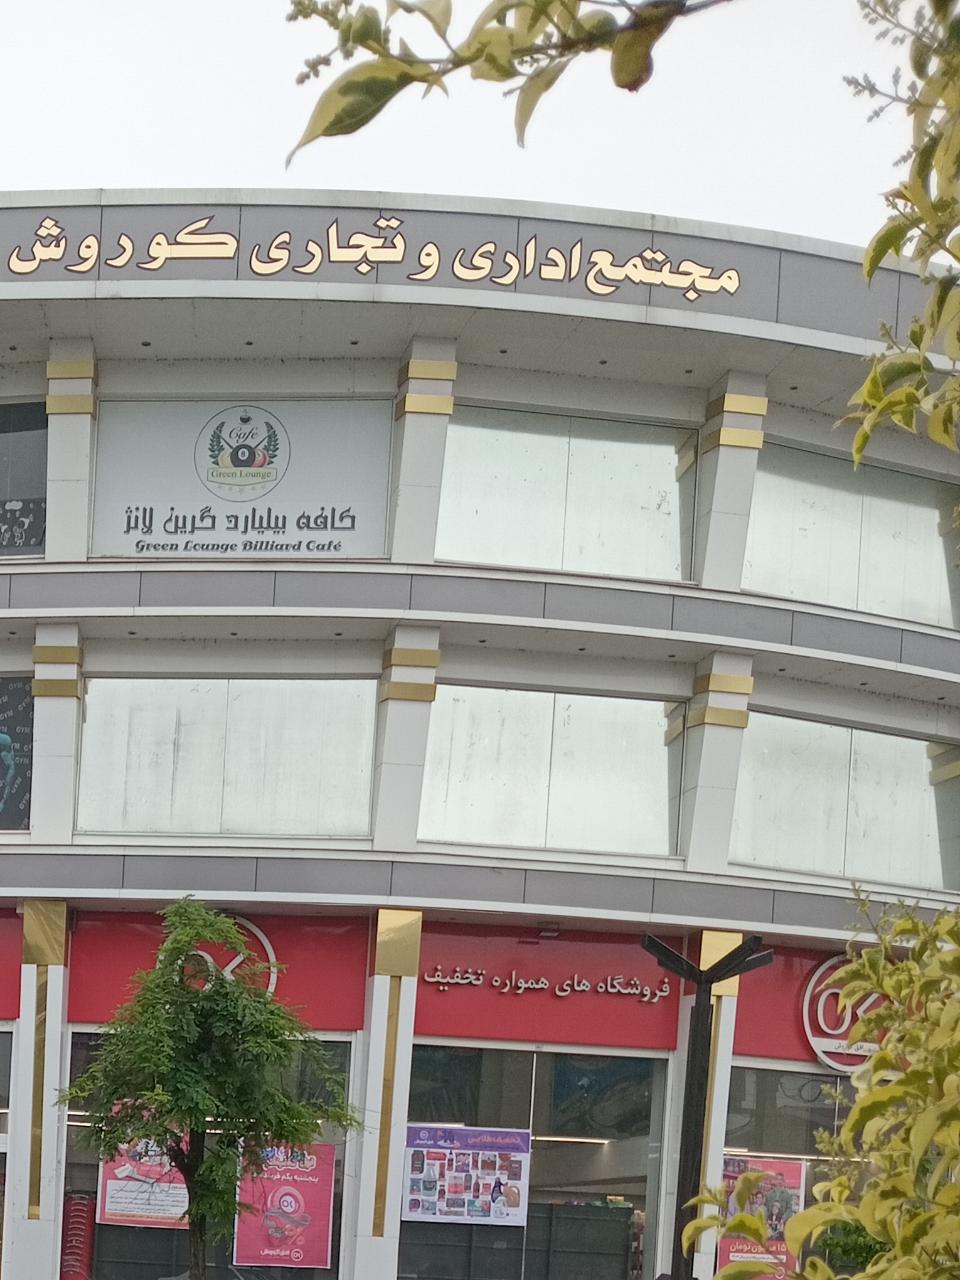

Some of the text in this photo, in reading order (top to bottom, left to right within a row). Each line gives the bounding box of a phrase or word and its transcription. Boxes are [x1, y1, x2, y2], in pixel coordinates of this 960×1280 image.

[7, 214, 741, 302] مجتمع اداری و تجاری کوروش
[211, 469, 271, 480] Green Lounge
[123, 505, 357, 536] کافه بیلیارد گرین لانژ
[135, 540, 179, 554] Green
[183, 540, 238, 554] Lounge
[241, 540, 302, 551] Billiard
[424, 965, 671, 1003] فروشگاه های همواره تخفیف
